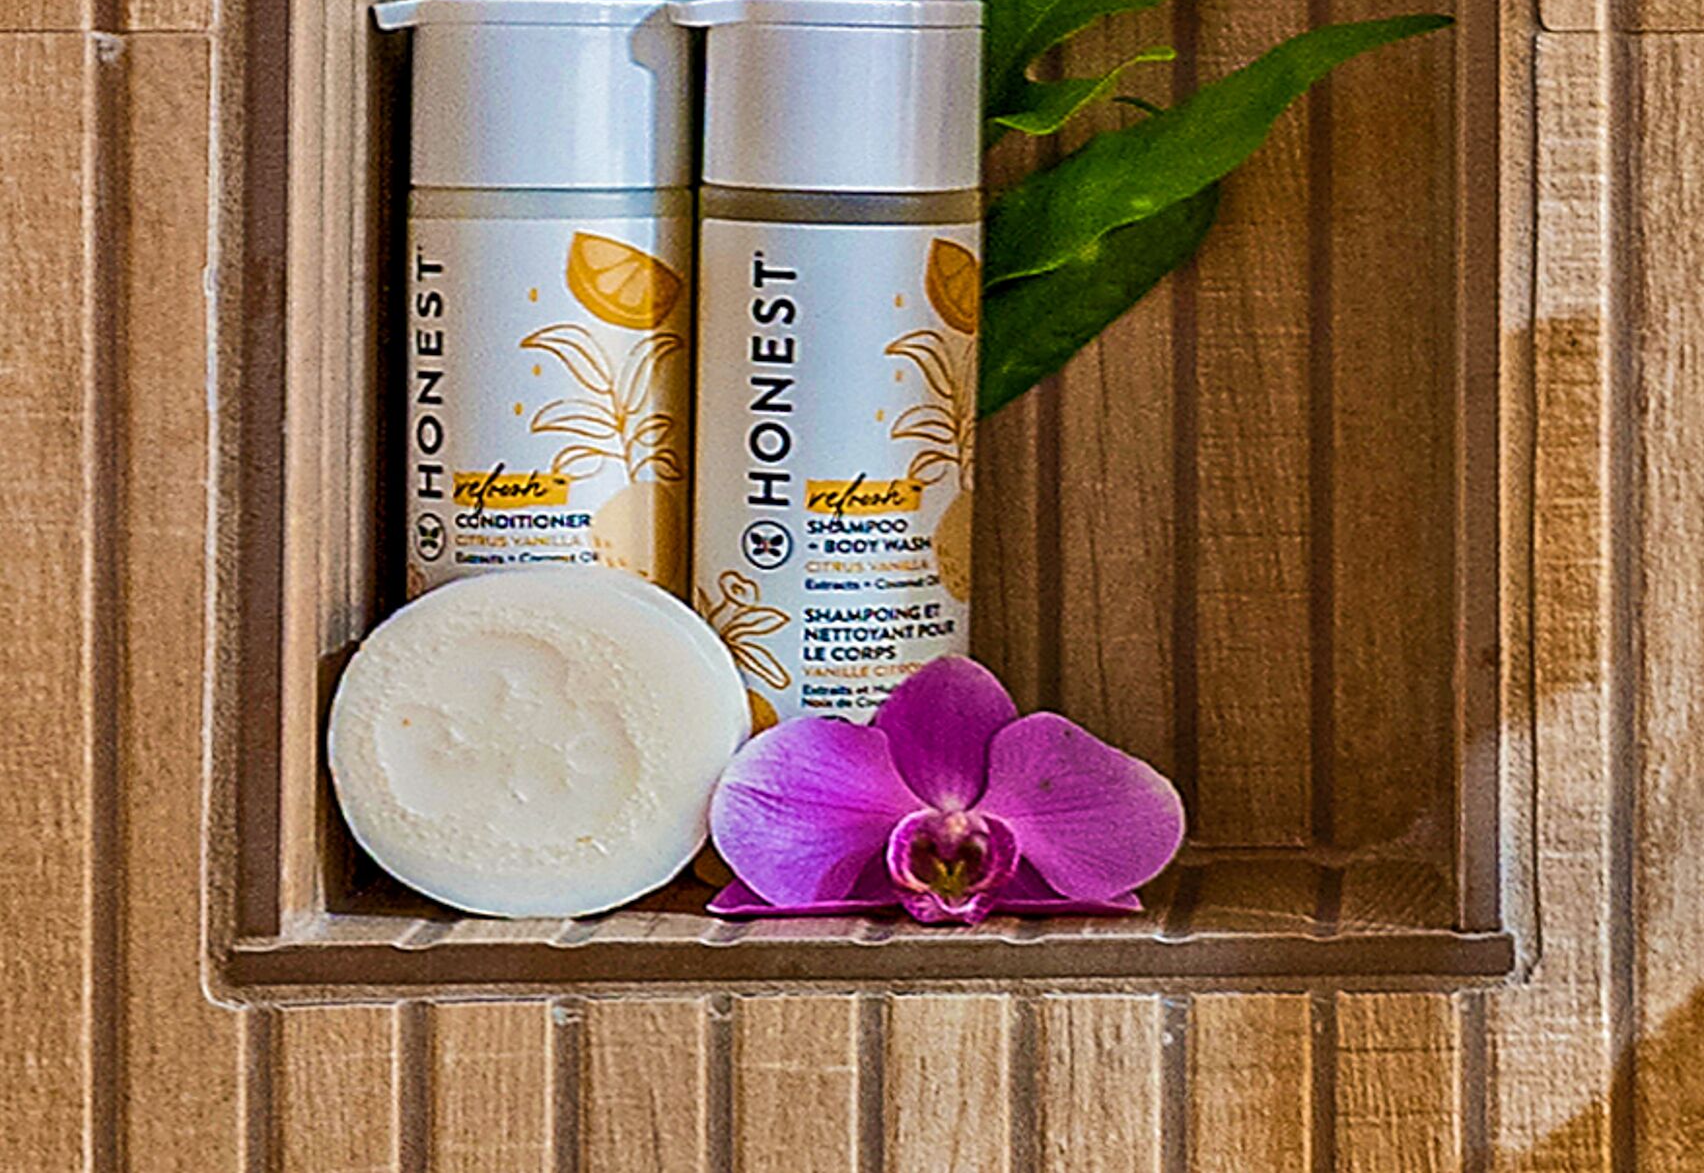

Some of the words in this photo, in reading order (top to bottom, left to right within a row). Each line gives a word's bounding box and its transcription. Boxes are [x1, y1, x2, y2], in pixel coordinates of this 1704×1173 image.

[416, 254, 445, 499] HONEST
[747, 259, 798, 507] HONEST
[455, 514, 592, 529] CONDITIONER
[807, 519, 908, 534] SHAMPOO
[455, 535, 508, 547] CITRUS
[511, 535, 582, 547] VANILLA
[824, 540, 877, 553] BODY
[885, 537, 931, 552] WASH
[806, 560, 864, 573] CITRUS
[804, 605, 920, 622] SHAMPOING
[924, 603, 941, 619] ET
[804, 625, 914, 642] NETTOYANT
[918, 621, 954, 638] POUR
[804, 647, 826, 661] LE
[831, 645, 896, 661] CORPS
[803, 666, 869, 678] VANILLE
